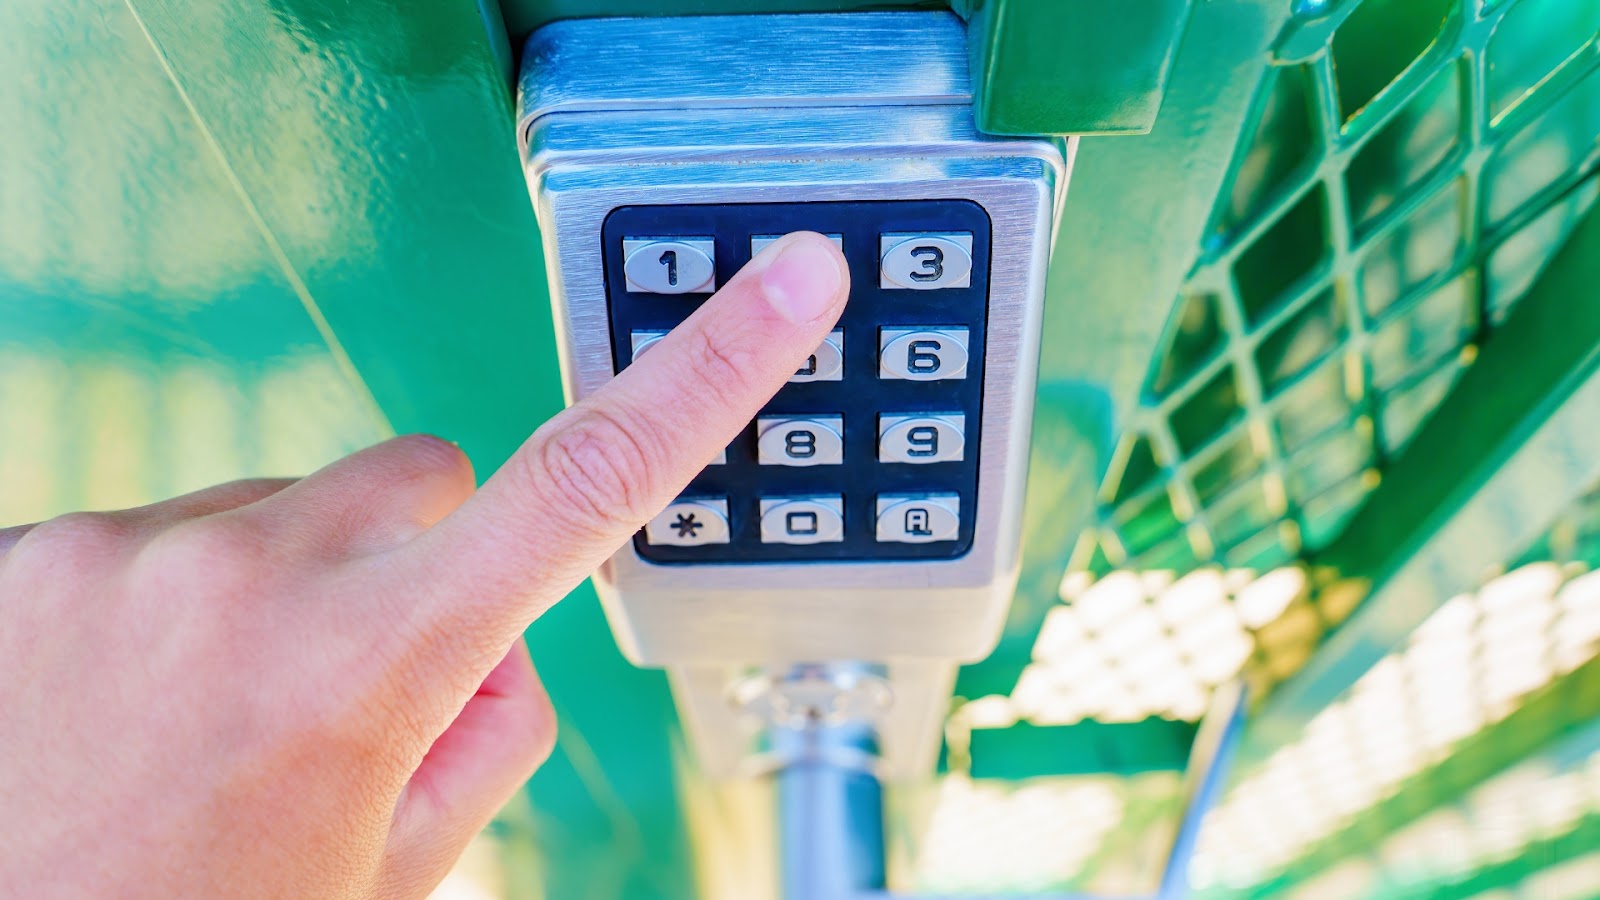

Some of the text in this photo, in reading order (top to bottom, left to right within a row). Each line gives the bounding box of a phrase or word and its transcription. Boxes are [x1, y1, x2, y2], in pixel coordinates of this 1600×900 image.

[658, 250, 678, 286] 1
[909, 245, 944, 282] 3
[907, 340, 942, 374] 6
[784, 430, 816, 459] 8
[906, 426, 939, 457] 9
